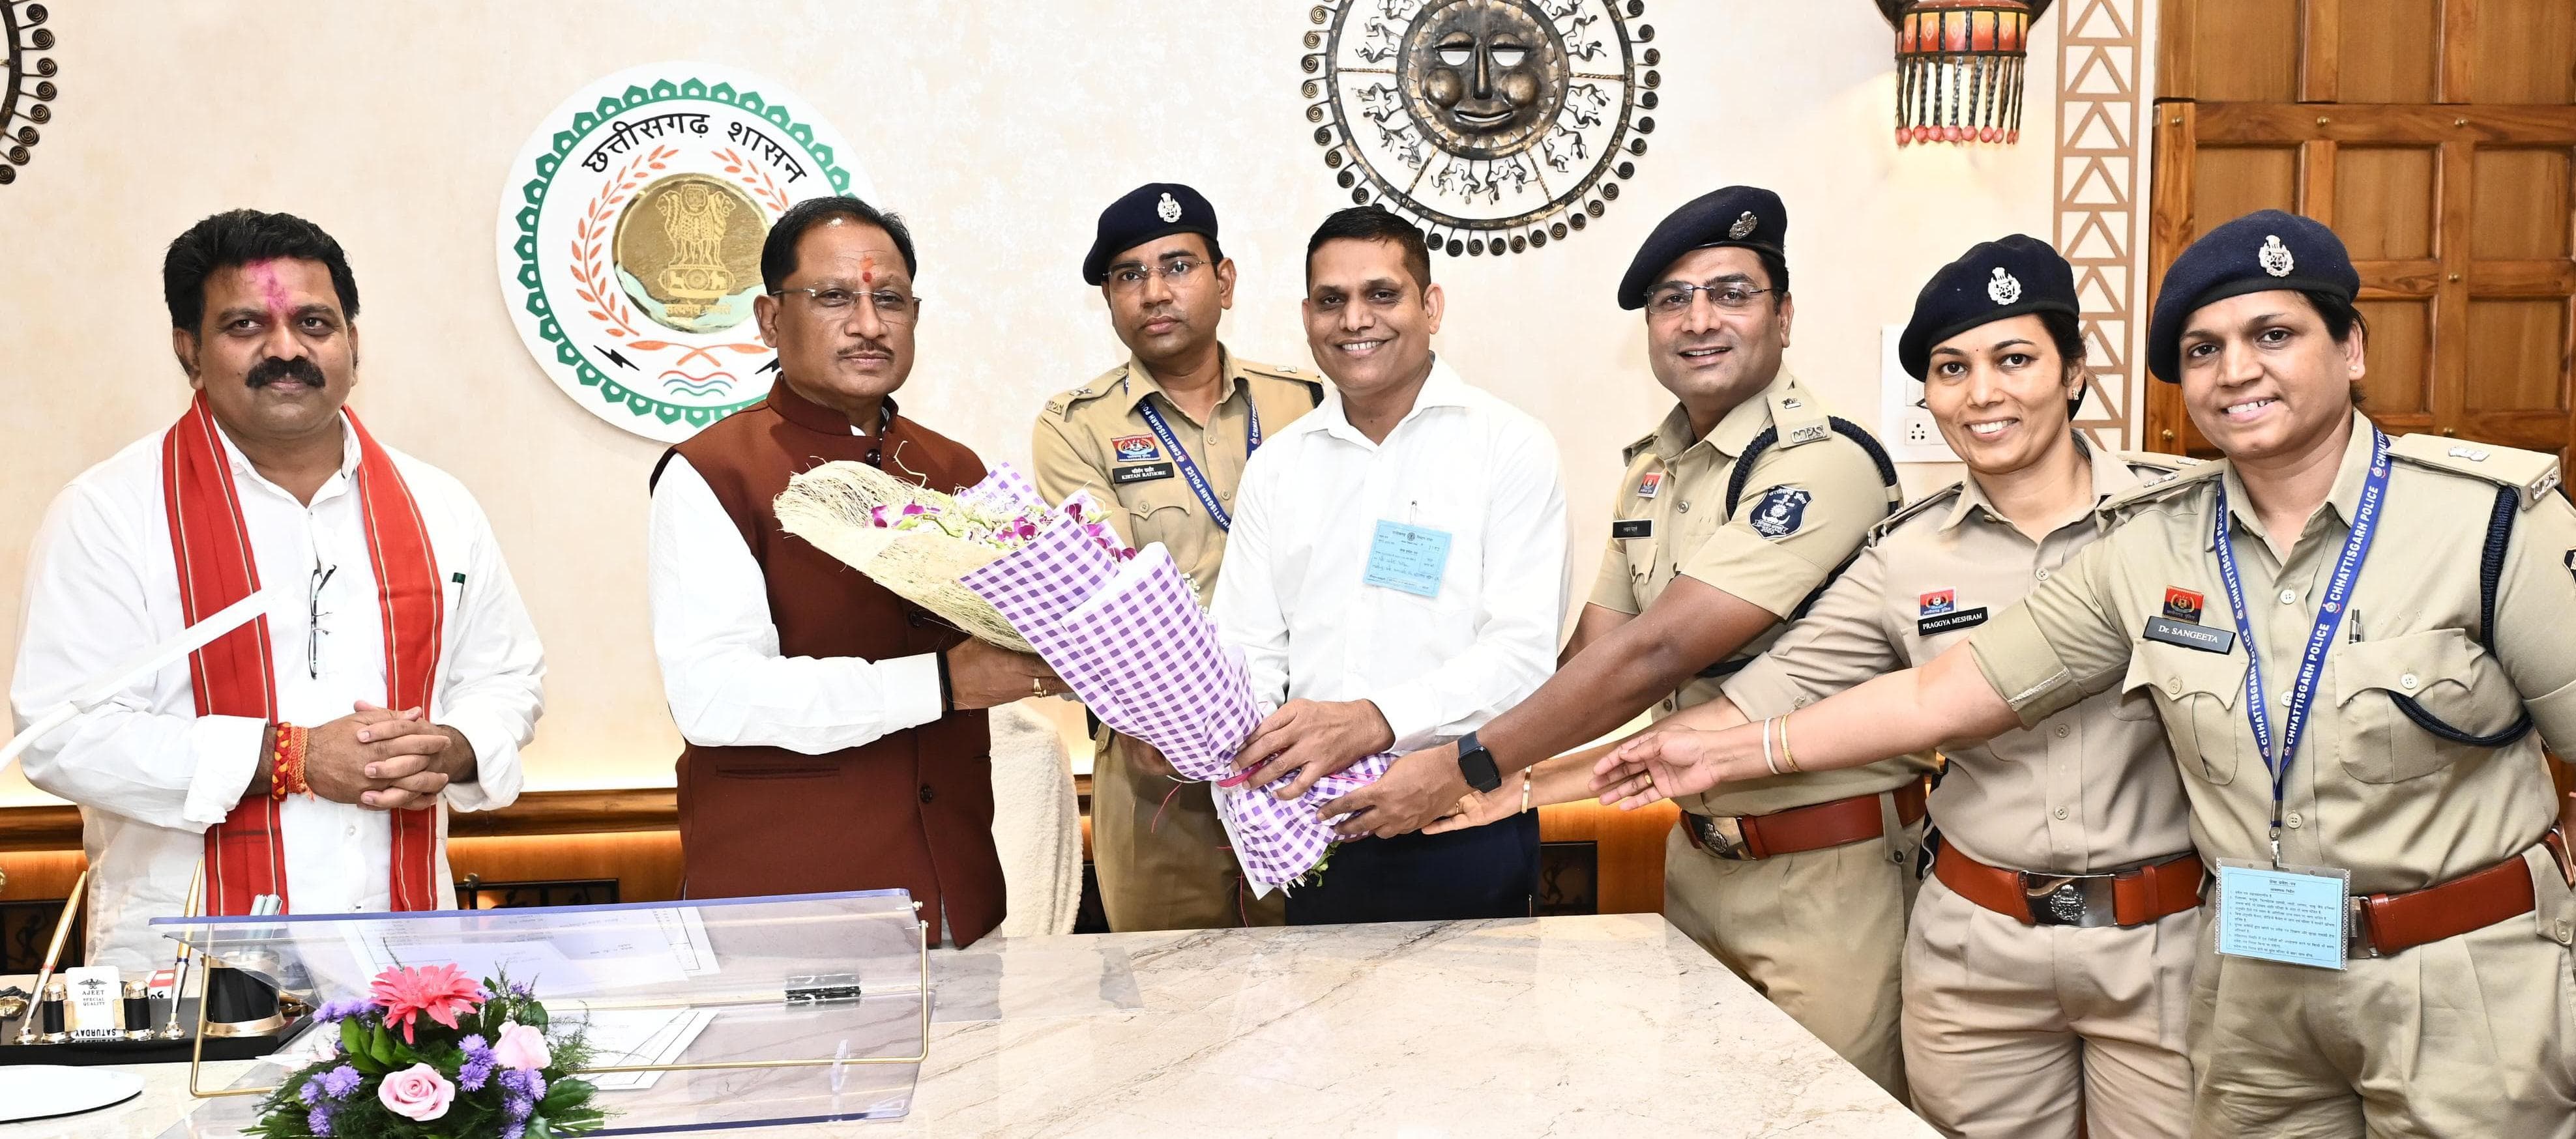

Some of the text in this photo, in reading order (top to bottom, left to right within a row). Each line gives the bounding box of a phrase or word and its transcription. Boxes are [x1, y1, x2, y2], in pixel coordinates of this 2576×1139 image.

[581, 113, 807, 183] छत्तीसगढ़ शासन
[1149, 414, 1182, 457] CHHATTISGARH
[1184, 466, 1230, 528] HATTISGARH POLICE
[2218, 536, 2242, 609] CHHATTISGARH
[2330, 485, 2378, 601] CHHATTISGARH POLICE
[1923, 613, 1982, 629] PRAGGYA MESHRAM
[2158, 625, 2217, 643] Dr. SANGEETA
[2242, 628, 2268, 745] CHHATTISGARH POLICE
[2287, 623, 2330, 745] CHHATTISGARH POLICE
[75, 1028, 116, 1037] SATURDAY
